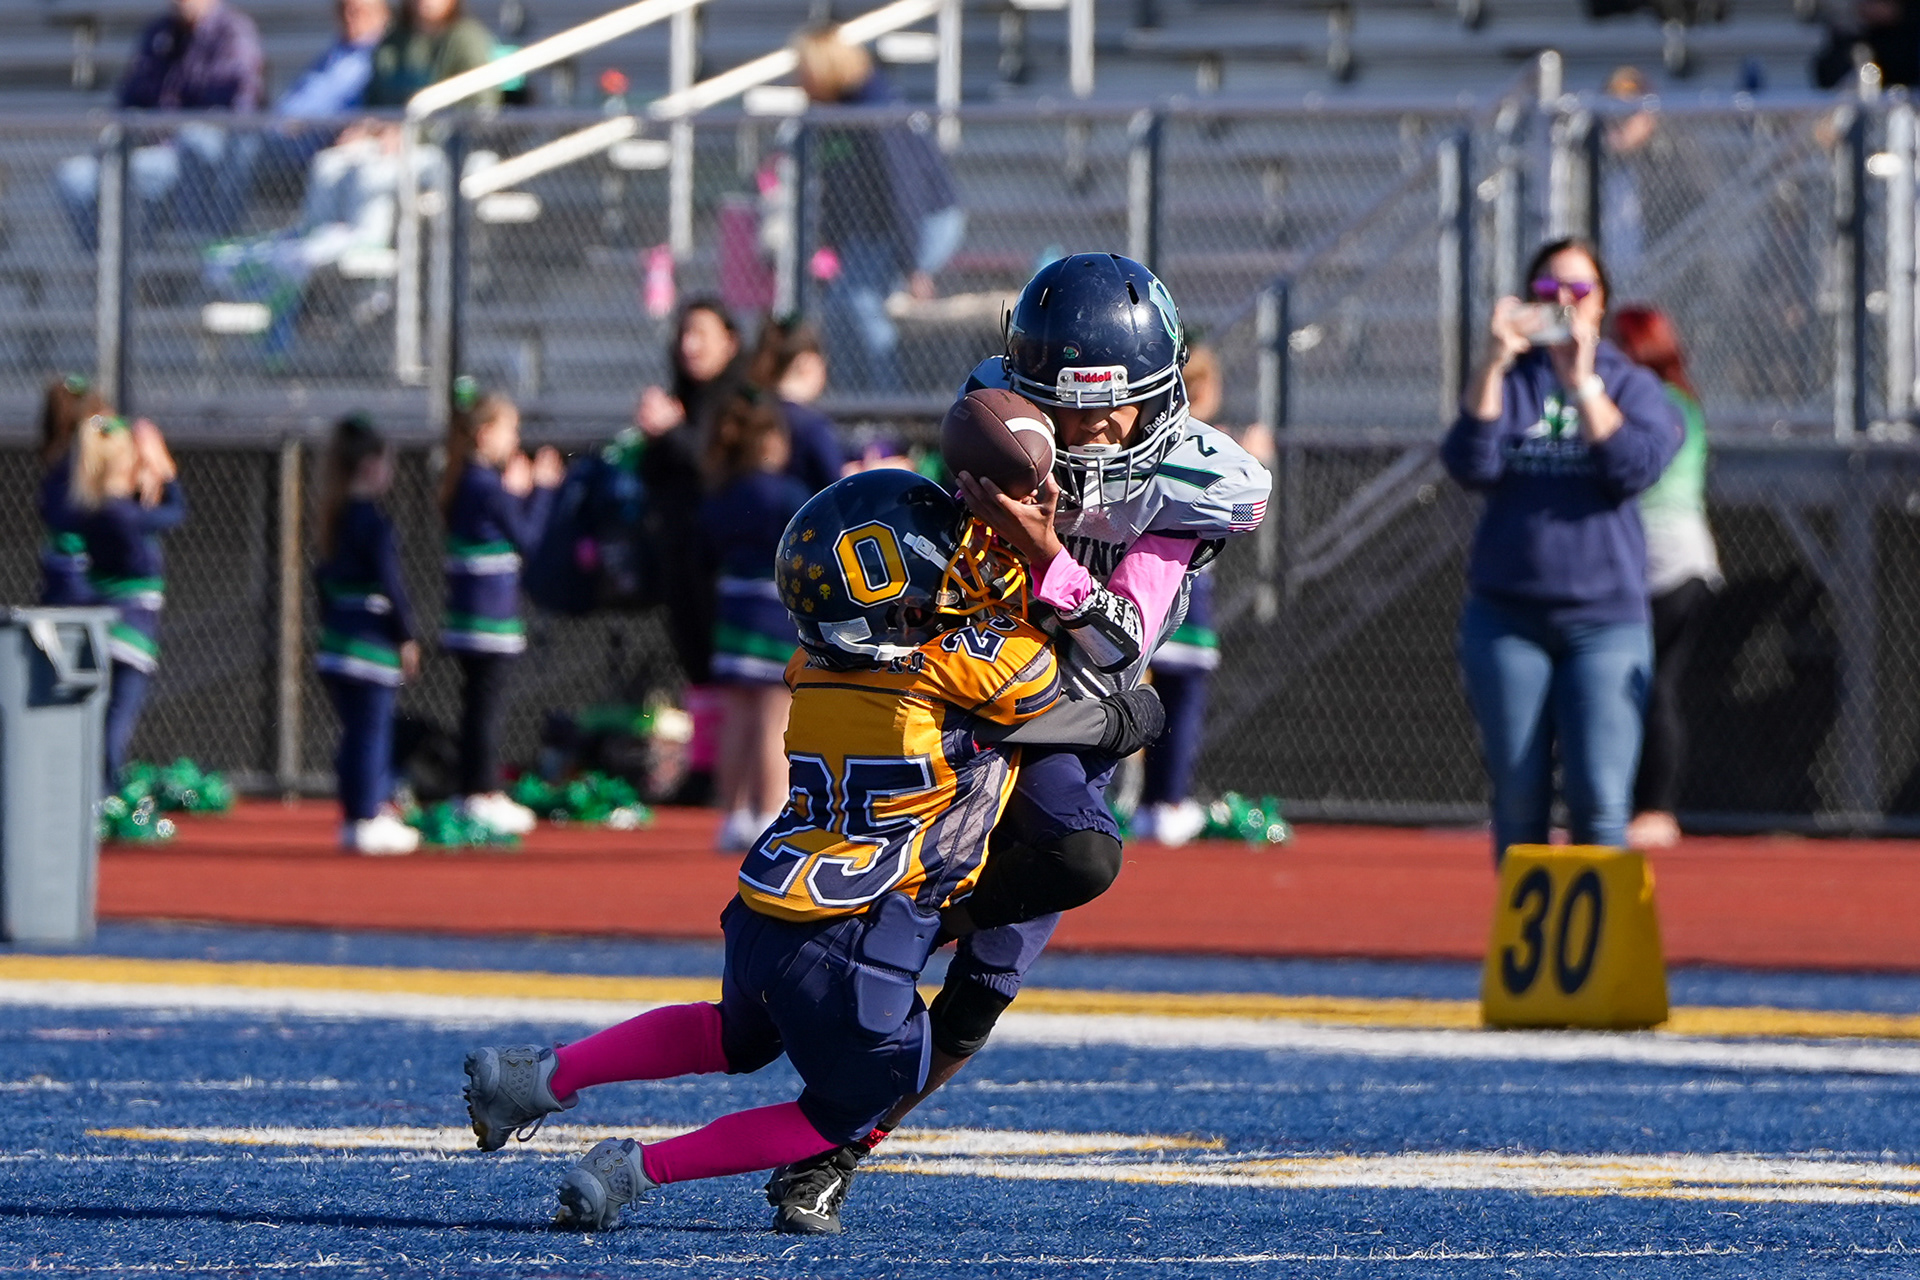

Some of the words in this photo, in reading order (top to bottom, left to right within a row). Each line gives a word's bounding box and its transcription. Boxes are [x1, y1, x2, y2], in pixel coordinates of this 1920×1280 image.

[1073, 371, 1112, 383] Riddell
[832, 519, 911, 608] O
[738, 750, 937, 909] 25
[1501, 867, 1603, 995] 30
